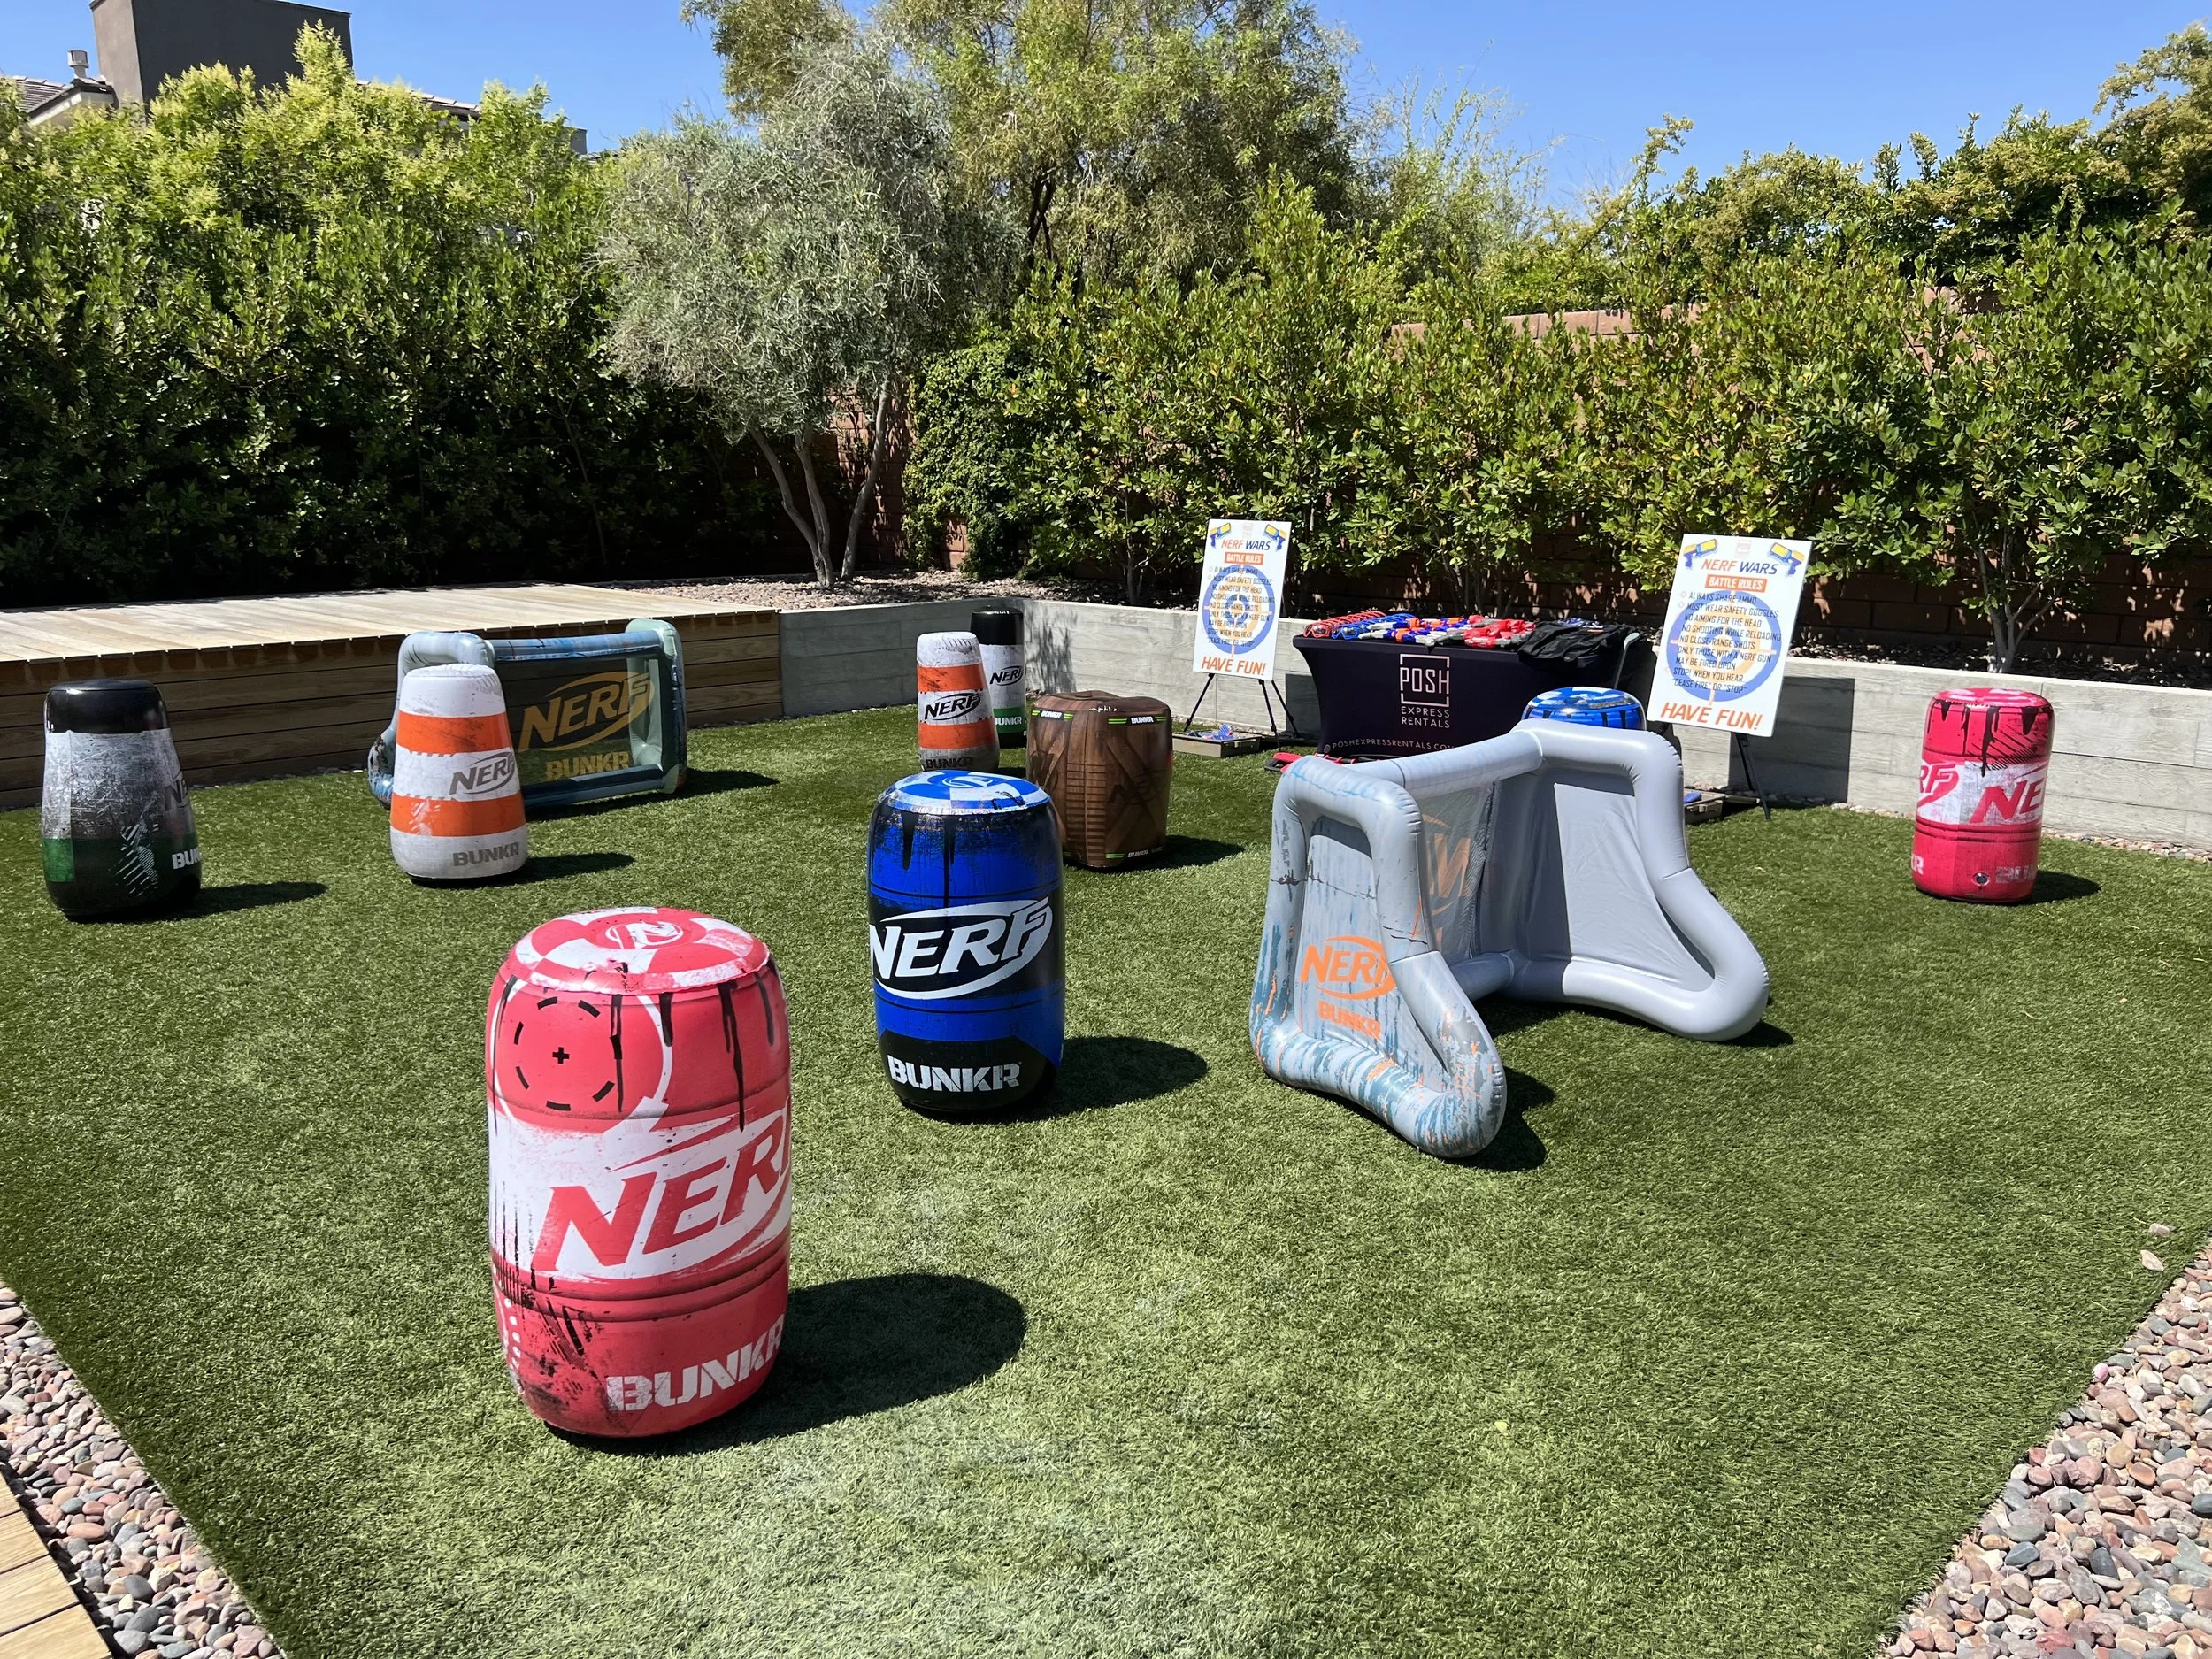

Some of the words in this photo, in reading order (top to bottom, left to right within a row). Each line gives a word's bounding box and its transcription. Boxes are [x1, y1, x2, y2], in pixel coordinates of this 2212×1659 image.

[1221, 540, 1244, 549] NERF
[1246, 540, 1271, 550] WARS
[1701, 558, 1738, 572] NERF
[1739, 561, 1778, 575] WARS
[1709, 577, 1738, 588] BATTLE
[1738, 579, 1764, 590] RULES
[1689, 591, 1714, 602] ALWAYS
[1715, 593, 1736, 603] SHARE
[1738, 595, 1757, 604] AMMO
[1686, 603, 1706, 611] MUST
[1706, 604, 1723, 613] WEAR
[1724, 605, 1748, 615] SAFETY
[1748, 608, 1778, 618] GOGGLES
[1694, 614, 1717, 624] AIMING
[1717, 616, 1730, 625] FOR
[1732, 617, 1743, 626] THE
[1744, 618, 1763, 627] HEAD
[1692, 625, 1724, 635] SHOOTING
[1724, 627, 1745, 637] WHILE
[1745, 629, 1782, 641] RELOADING
[1733, 641, 1756, 649] SHOTS
[1678, 645, 1694, 654] ONLY
[1695, 647, 1717, 656] THOSE
[1717, 649, 1732, 658] WITH
[1739, 652, 1757, 661] NERF
[1757, 654, 1771, 663] GUN
[1202, 657, 1233, 672] HAVE
[1236, 660, 1267, 676] FUN!
[1699, 658, 1717, 668] FIRED
[1717, 661, 1736, 670] UPON
[1400, 667, 1449, 695] POSH
[1693, 669, 1711, 679] WHEN
[518, 672, 650, 752] NERF
[925, 693, 980, 719] NERF
[1401, 706, 1450, 718] EXPRESS
[1402, 717, 1450, 728] RENTALS
[1660, 702, 1712, 723] HAVE
[1715, 710, 1763, 730] FUN!
[546, 751, 629, 780] BUNKR
[926, 757, 972, 769] BUNKR
[453, 841, 519, 866] BUNKR
[869, 895, 1049, 979] NERF
[1317, 999, 1381, 1040] BUNKR
[887, 1054, 1021, 1092] BUNKR
